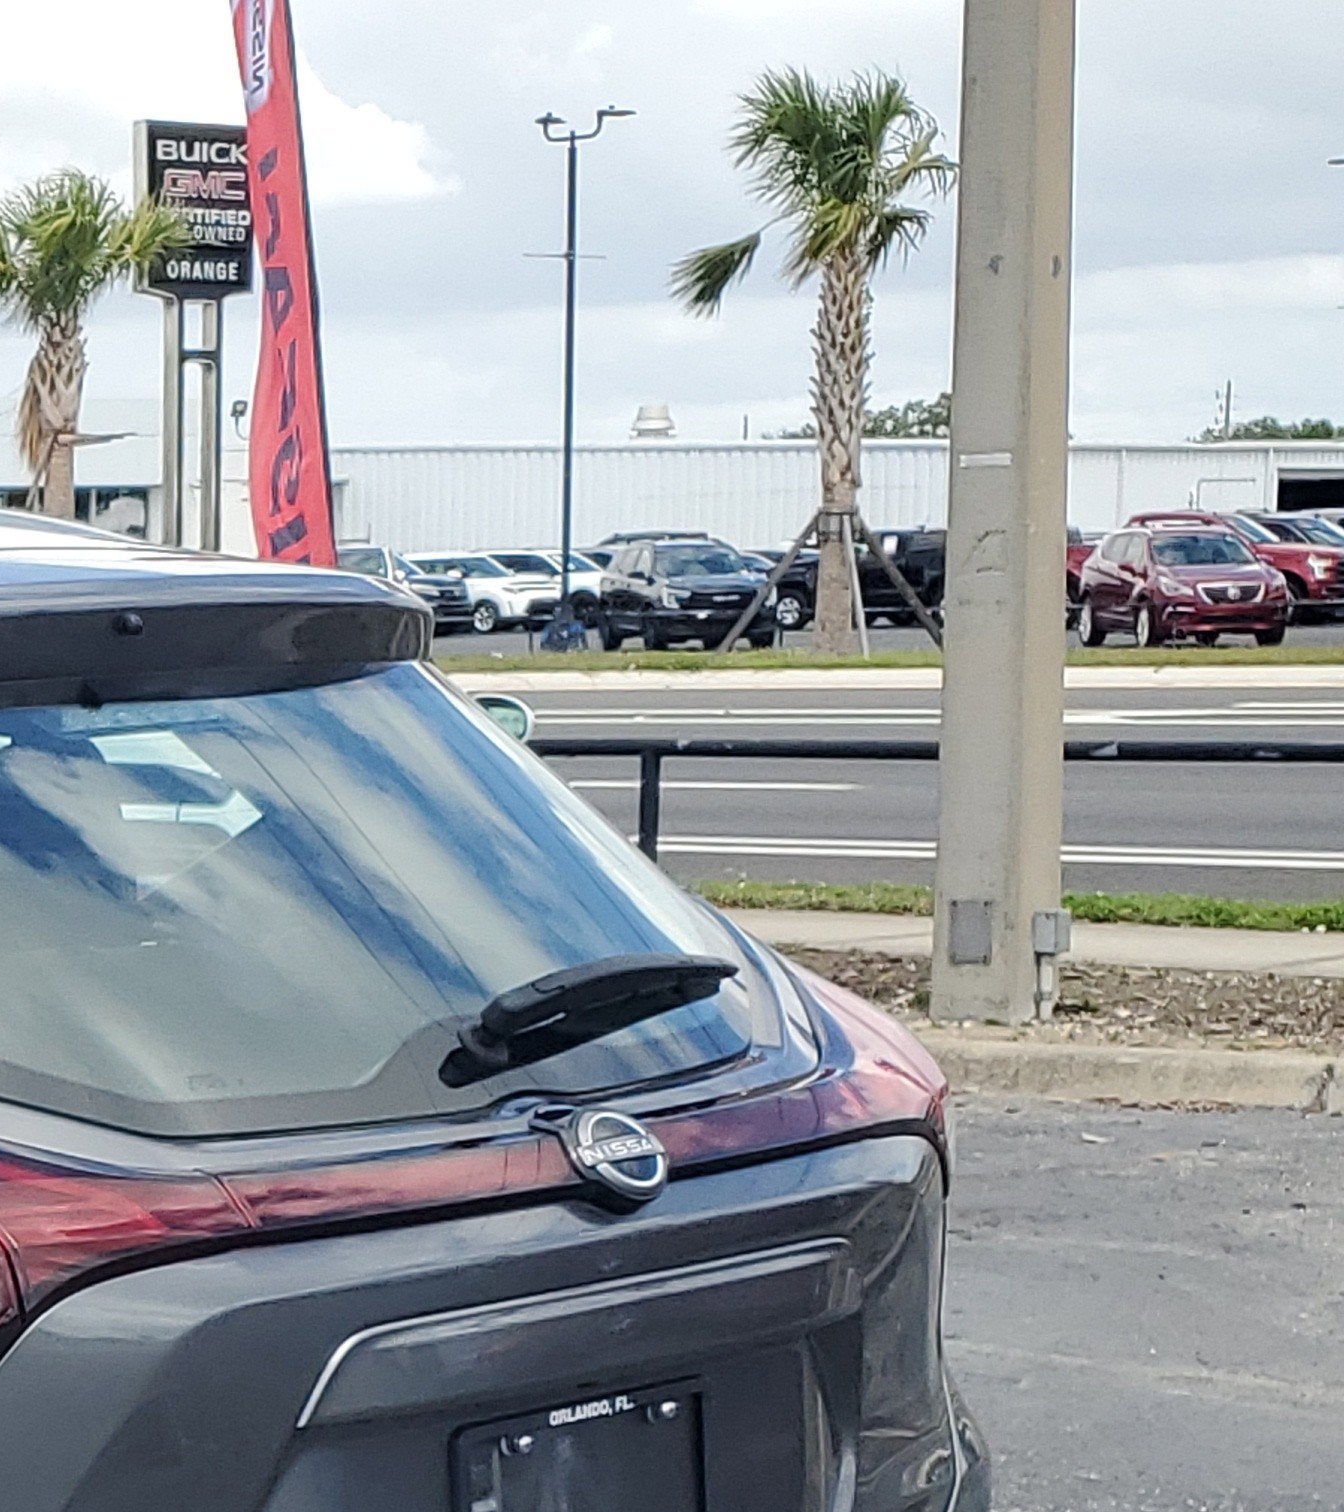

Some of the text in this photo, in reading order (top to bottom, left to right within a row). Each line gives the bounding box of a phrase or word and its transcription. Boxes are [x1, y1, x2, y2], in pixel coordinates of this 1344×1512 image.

[156, 138, 249, 164] BUICK
[164, 168, 246, 200] GMC
[165, 260, 239, 281] ORANGE
[548, 1398, 613, 1427] ORLANDO,
